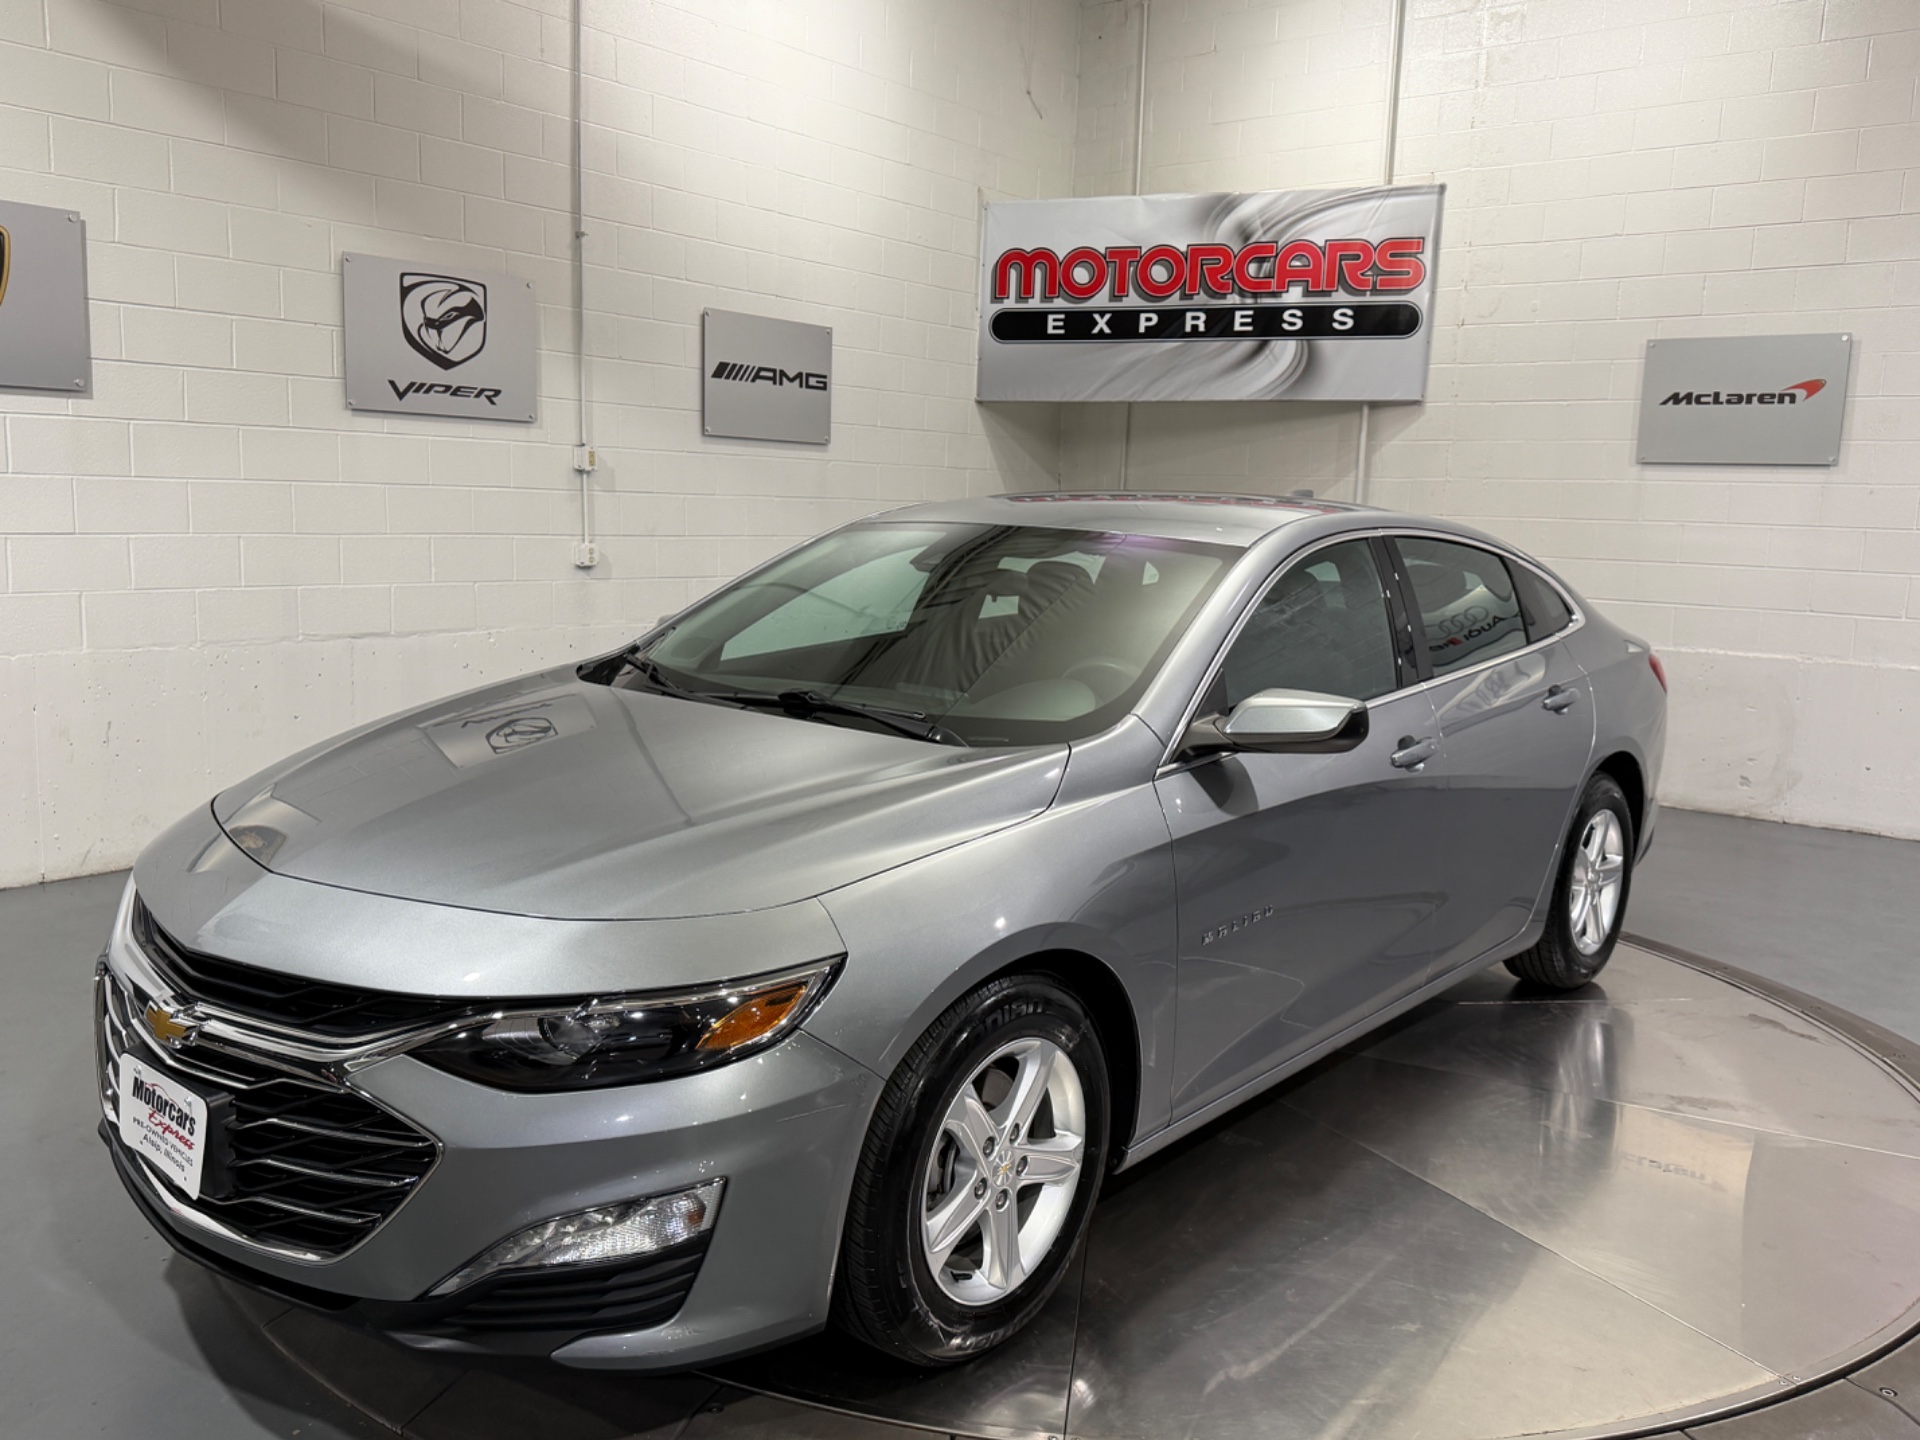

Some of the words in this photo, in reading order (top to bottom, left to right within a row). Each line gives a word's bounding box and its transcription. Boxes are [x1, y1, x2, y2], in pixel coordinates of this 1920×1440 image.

[993, 238, 1427, 299] MOTORCARS
[1046, 307, 1355, 334] EXPRESS
[387, 379, 502, 406] VIPER
[750, 366, 828, 391] AMG
[1659, 391, 1797, 406] McLaren
[1201, 904, 1274, 946] MALIBU
[132, 1075, 196, 1137] Motorcars
[148, 1110, 195, 1151] Express
